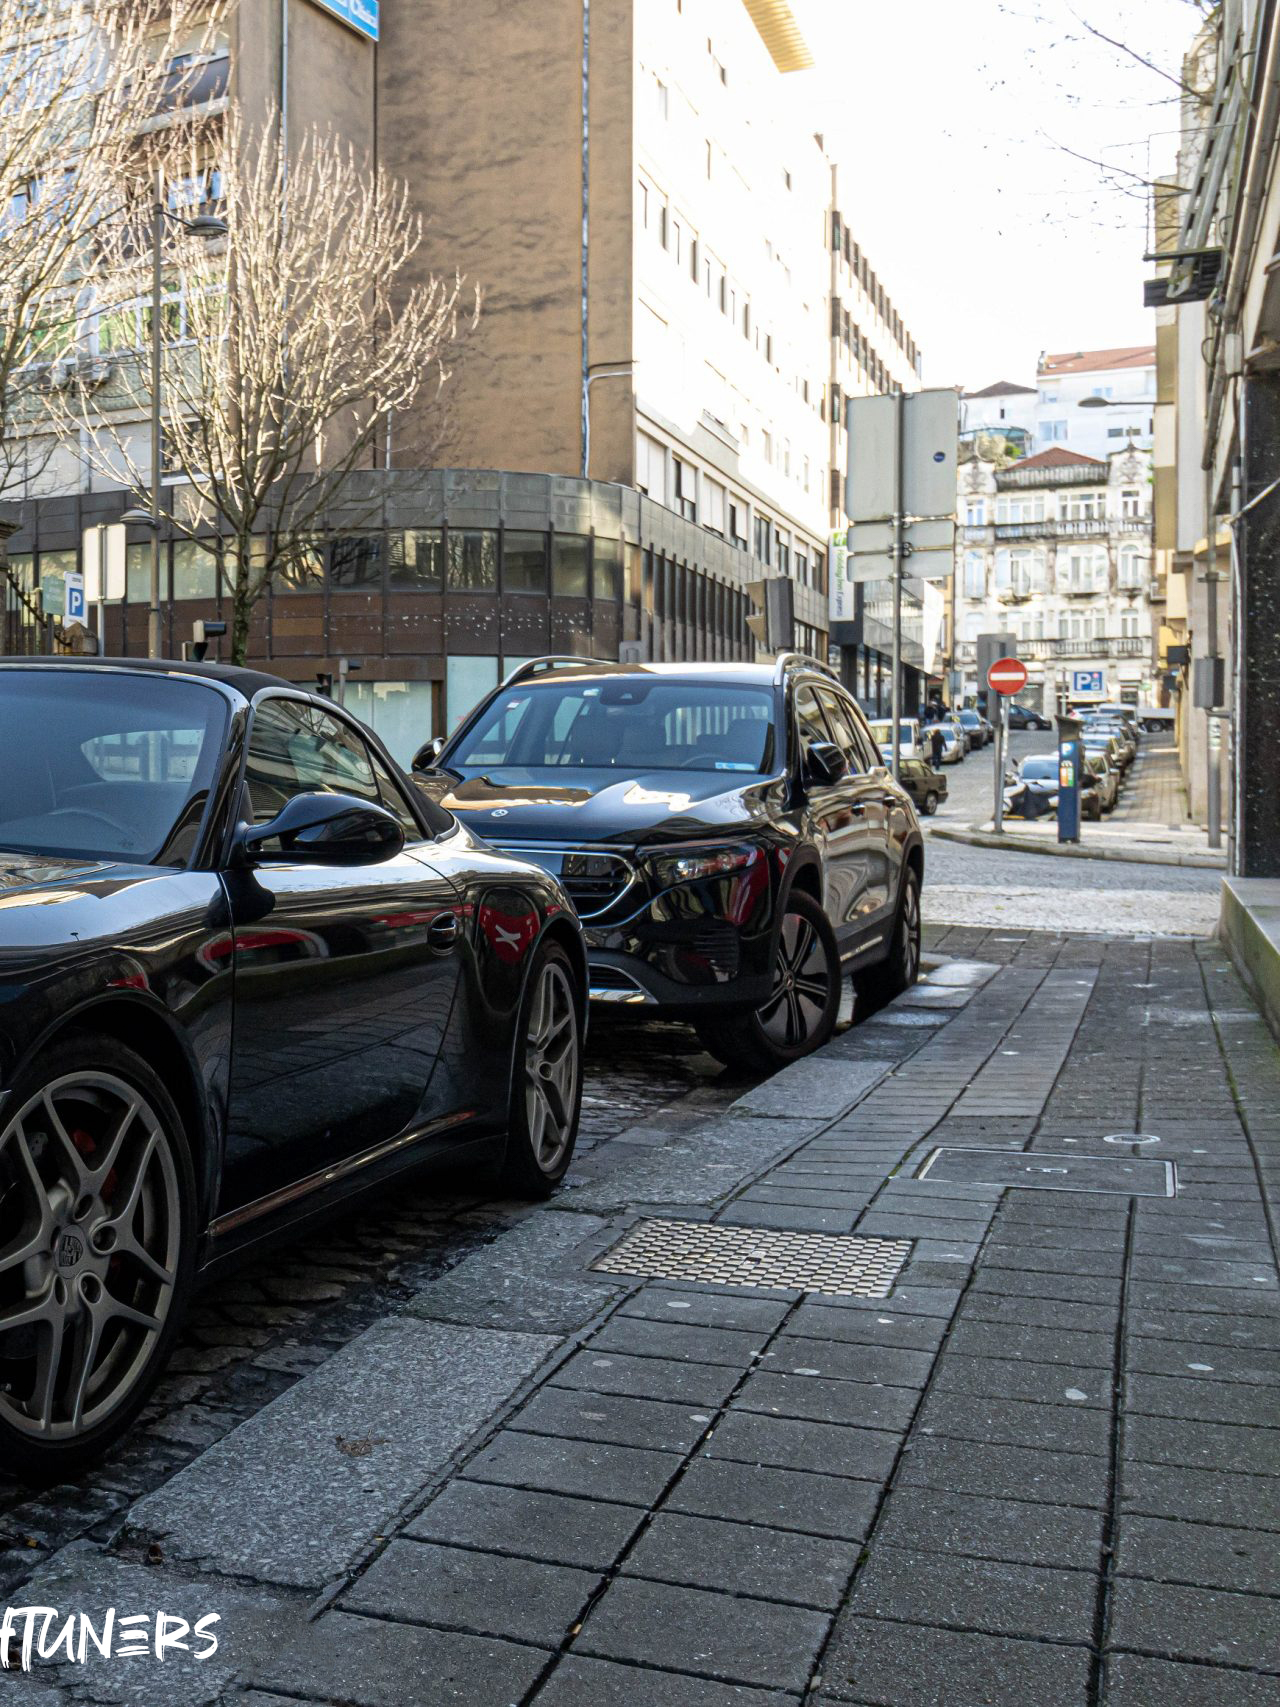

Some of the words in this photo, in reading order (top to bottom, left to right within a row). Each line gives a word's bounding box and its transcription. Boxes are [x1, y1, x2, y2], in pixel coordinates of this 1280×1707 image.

[835, 549, 844, 578] Holiday
[71, 591, 82, 614] P
[1077, 673, 1091, 690] P
